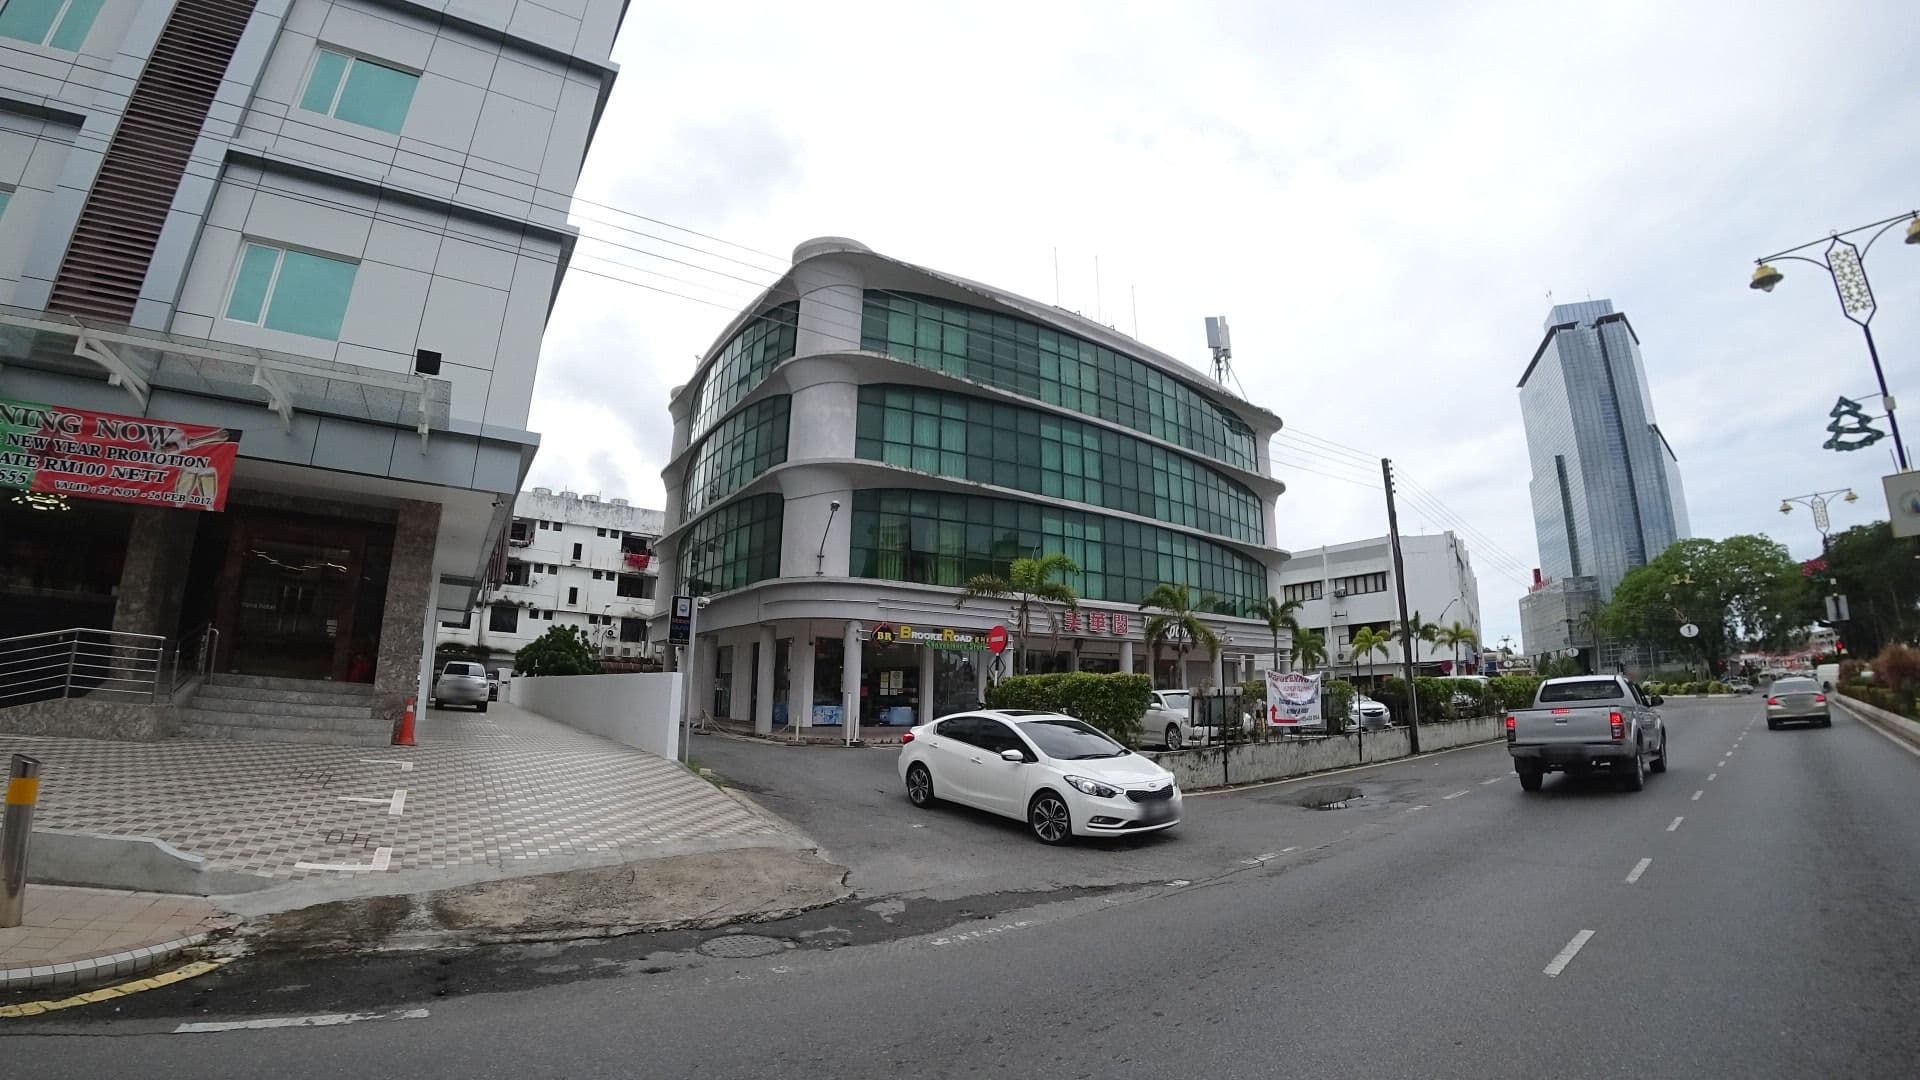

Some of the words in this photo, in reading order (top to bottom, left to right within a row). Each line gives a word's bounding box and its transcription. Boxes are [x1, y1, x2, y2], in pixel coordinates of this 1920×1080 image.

[0, 404, 82, 435] NING
[93, 417, 176, 447] NOW
[7, 433, 49, 450] NEW
[54, 439, 101, 457] YEAR
[105, 447, 209, 469] PROMOTION
[43, 457, 106, 477] RM100
[110, 466, 169, 483] NETT
[55, 480, 90, 493] VALID
[113, 486, 140, 498] NOV
[163, 492, 186, 503] FEB
[187, 494, 213, 506] 2017
[877, 631, 892, 641] BR
